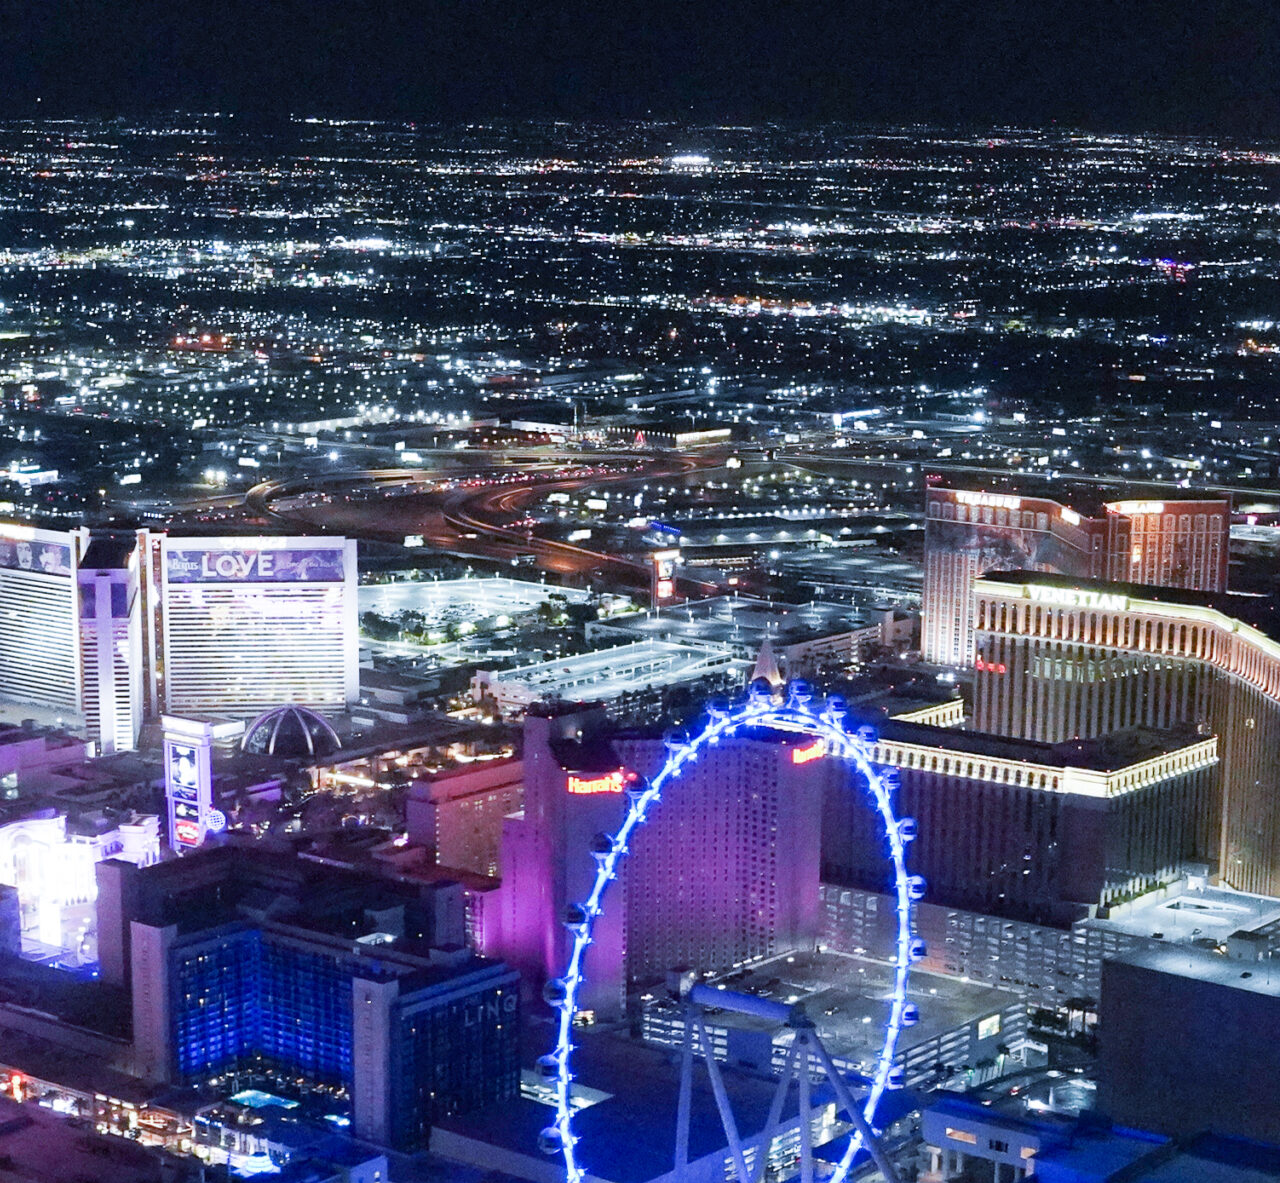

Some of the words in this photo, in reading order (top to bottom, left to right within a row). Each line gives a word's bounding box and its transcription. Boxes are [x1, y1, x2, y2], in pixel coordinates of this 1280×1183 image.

[201, 553, 274, 577] LOVE
[1029, 584, 1129, 611] VENETIAN
[464, 994, 518, 1027] LINQ
